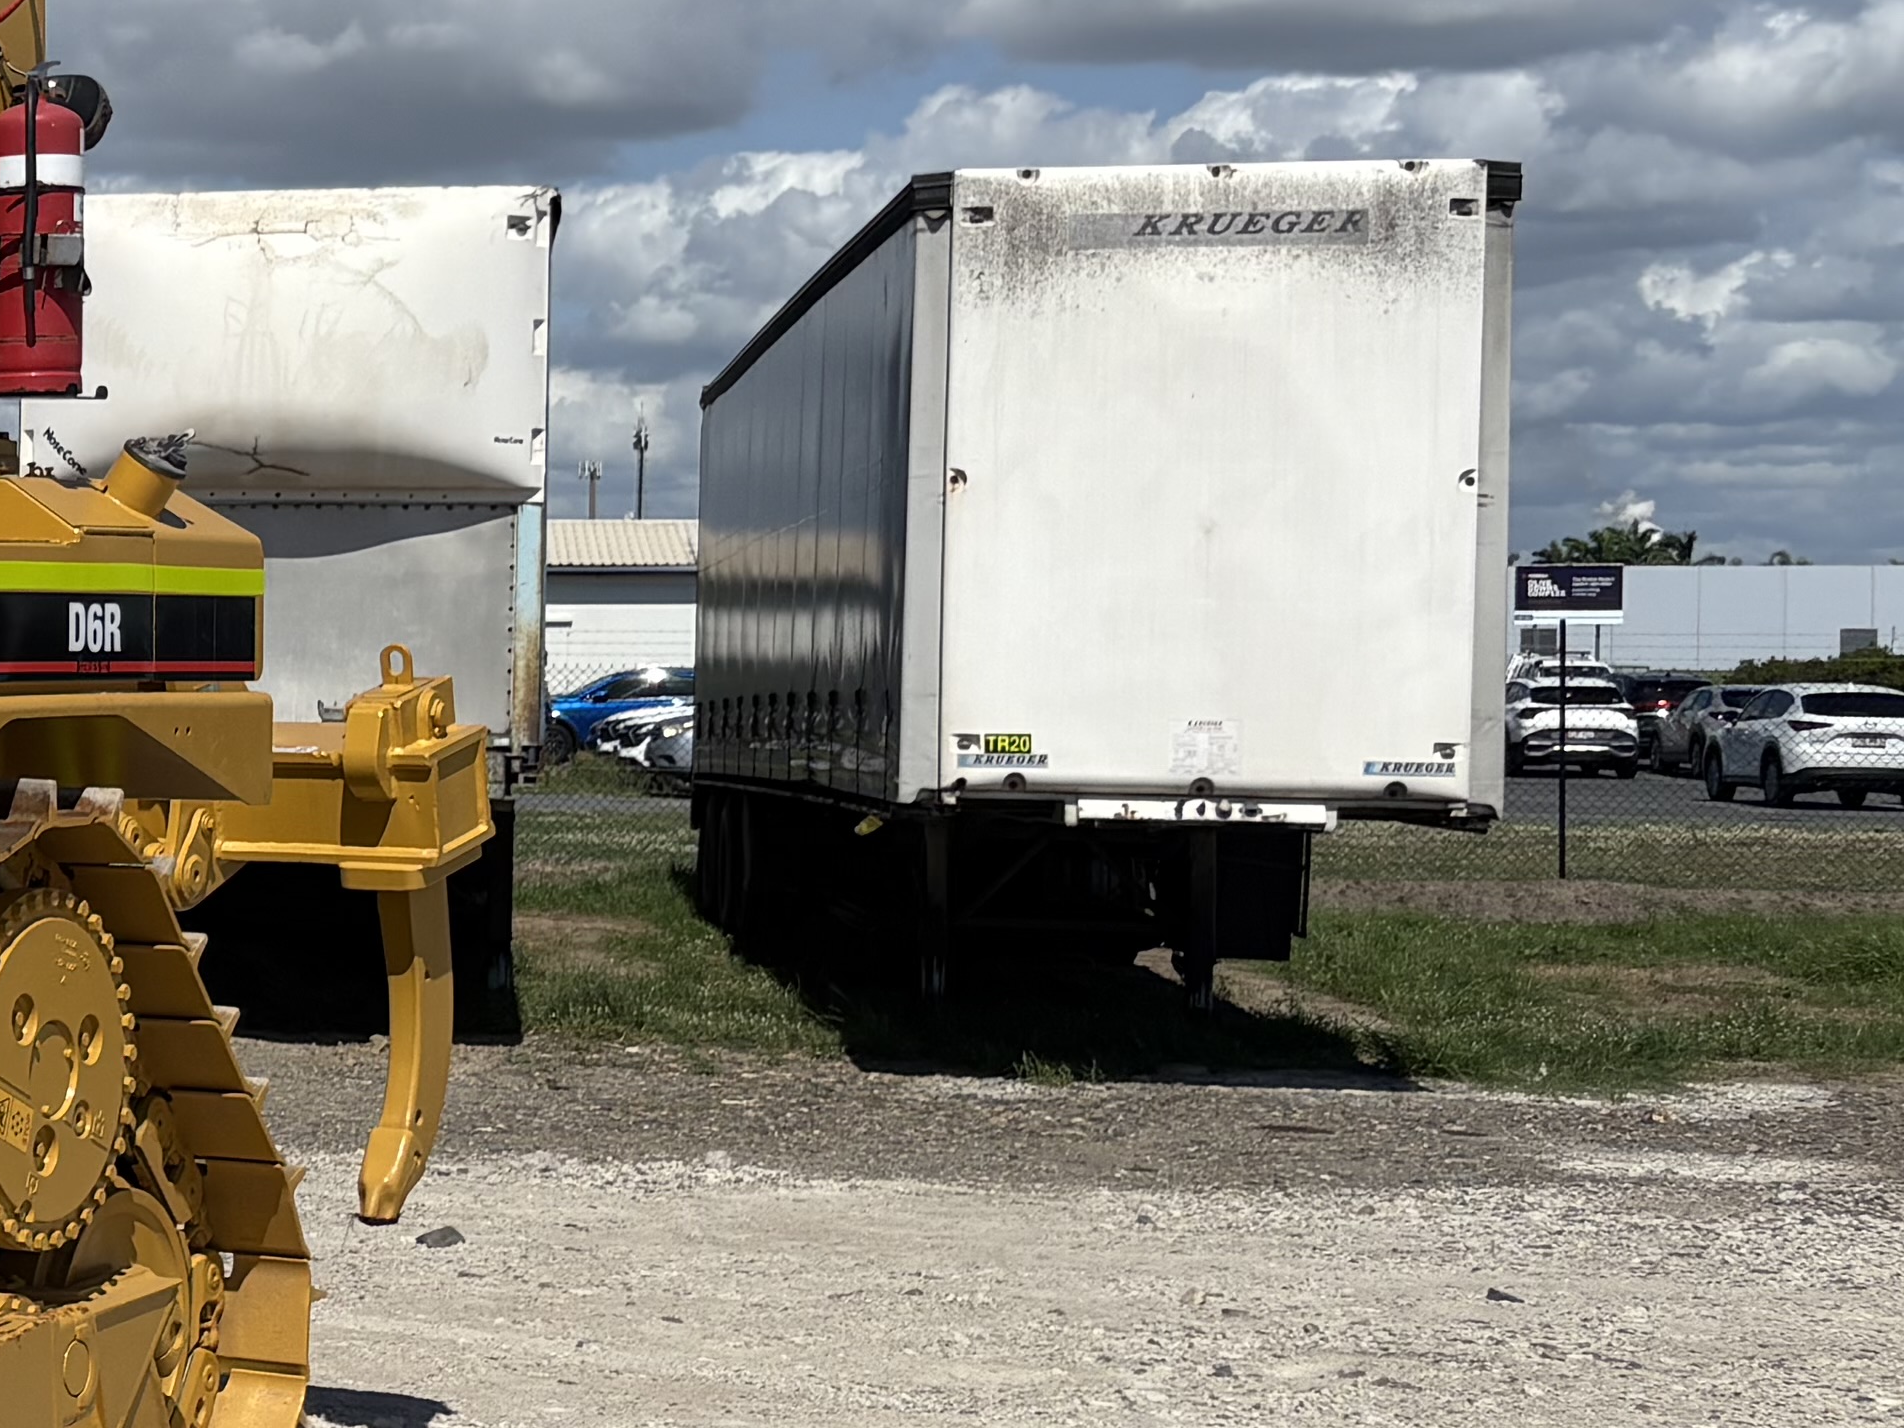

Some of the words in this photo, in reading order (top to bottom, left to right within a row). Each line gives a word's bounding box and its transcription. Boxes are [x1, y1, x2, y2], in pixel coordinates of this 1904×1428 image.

[1133, 210, 1364, 237] KRUEGER
[68, 602, 122, 653] D6R
[985, 735, 1031, 753] TR20
